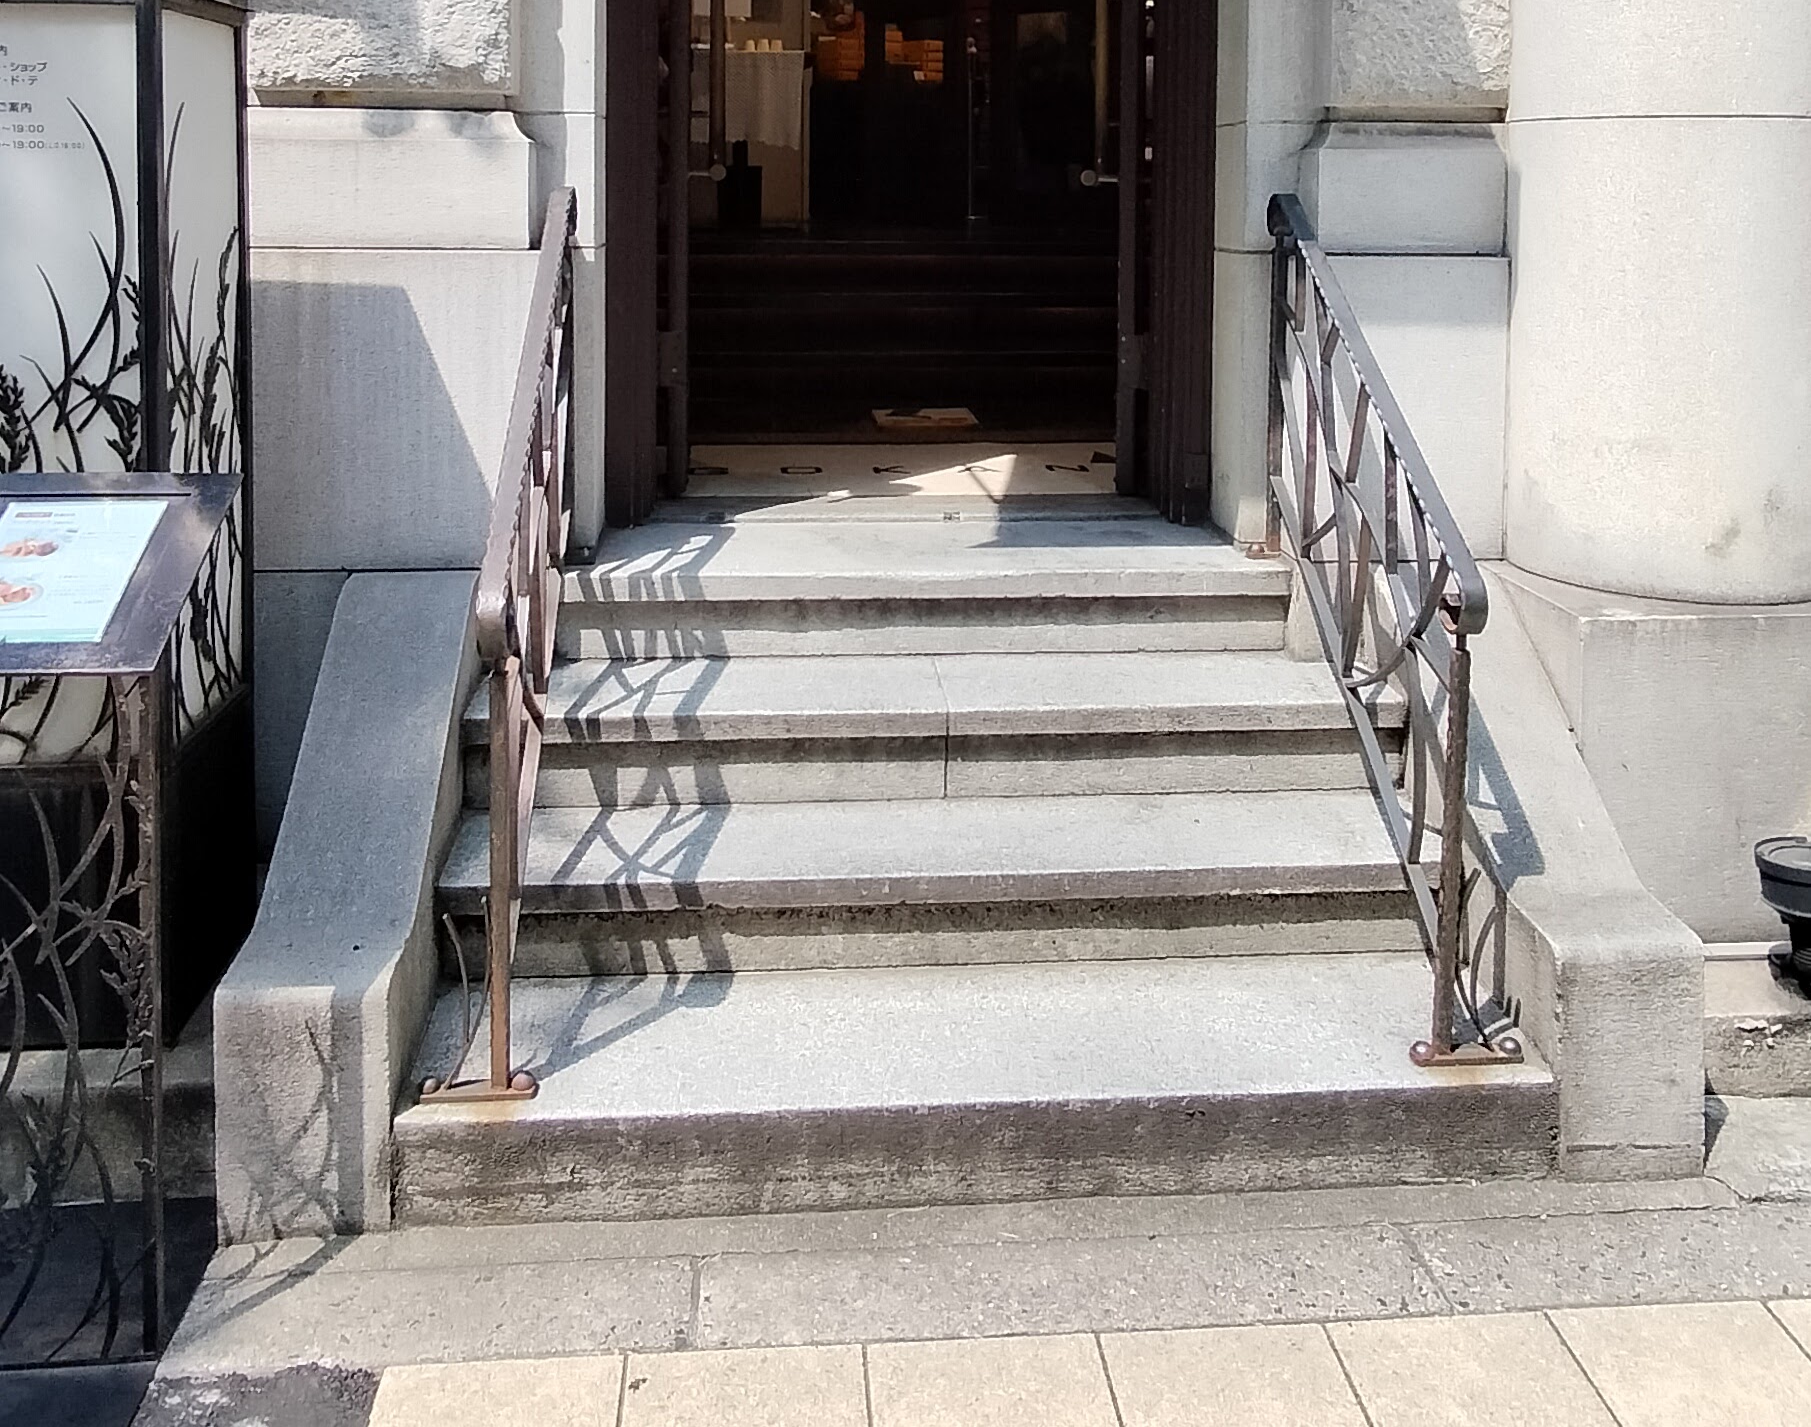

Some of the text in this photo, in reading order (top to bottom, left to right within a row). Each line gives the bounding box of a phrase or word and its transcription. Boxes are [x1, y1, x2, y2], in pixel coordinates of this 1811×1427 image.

[0, 61, 48, 72] ・ショップ
[0, 75, 38, 86] ・ド・テ
